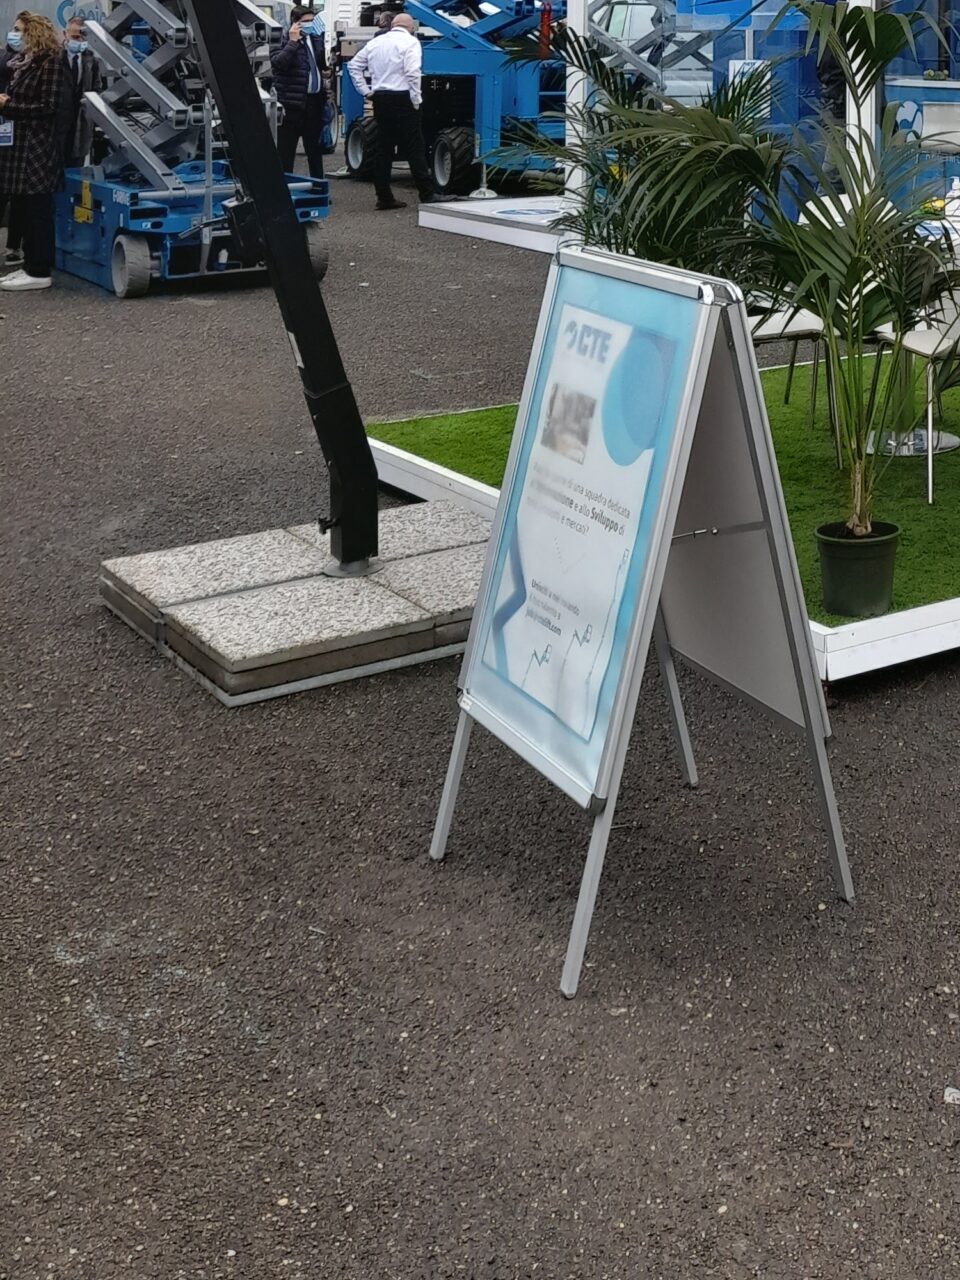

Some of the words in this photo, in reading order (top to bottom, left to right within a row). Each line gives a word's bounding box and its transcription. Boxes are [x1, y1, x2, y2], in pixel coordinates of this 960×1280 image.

[576, 323, 613, 364] CTE
[585, 488, 607, 507] squadra
[590, 506, 619, 533] Sviluppo
